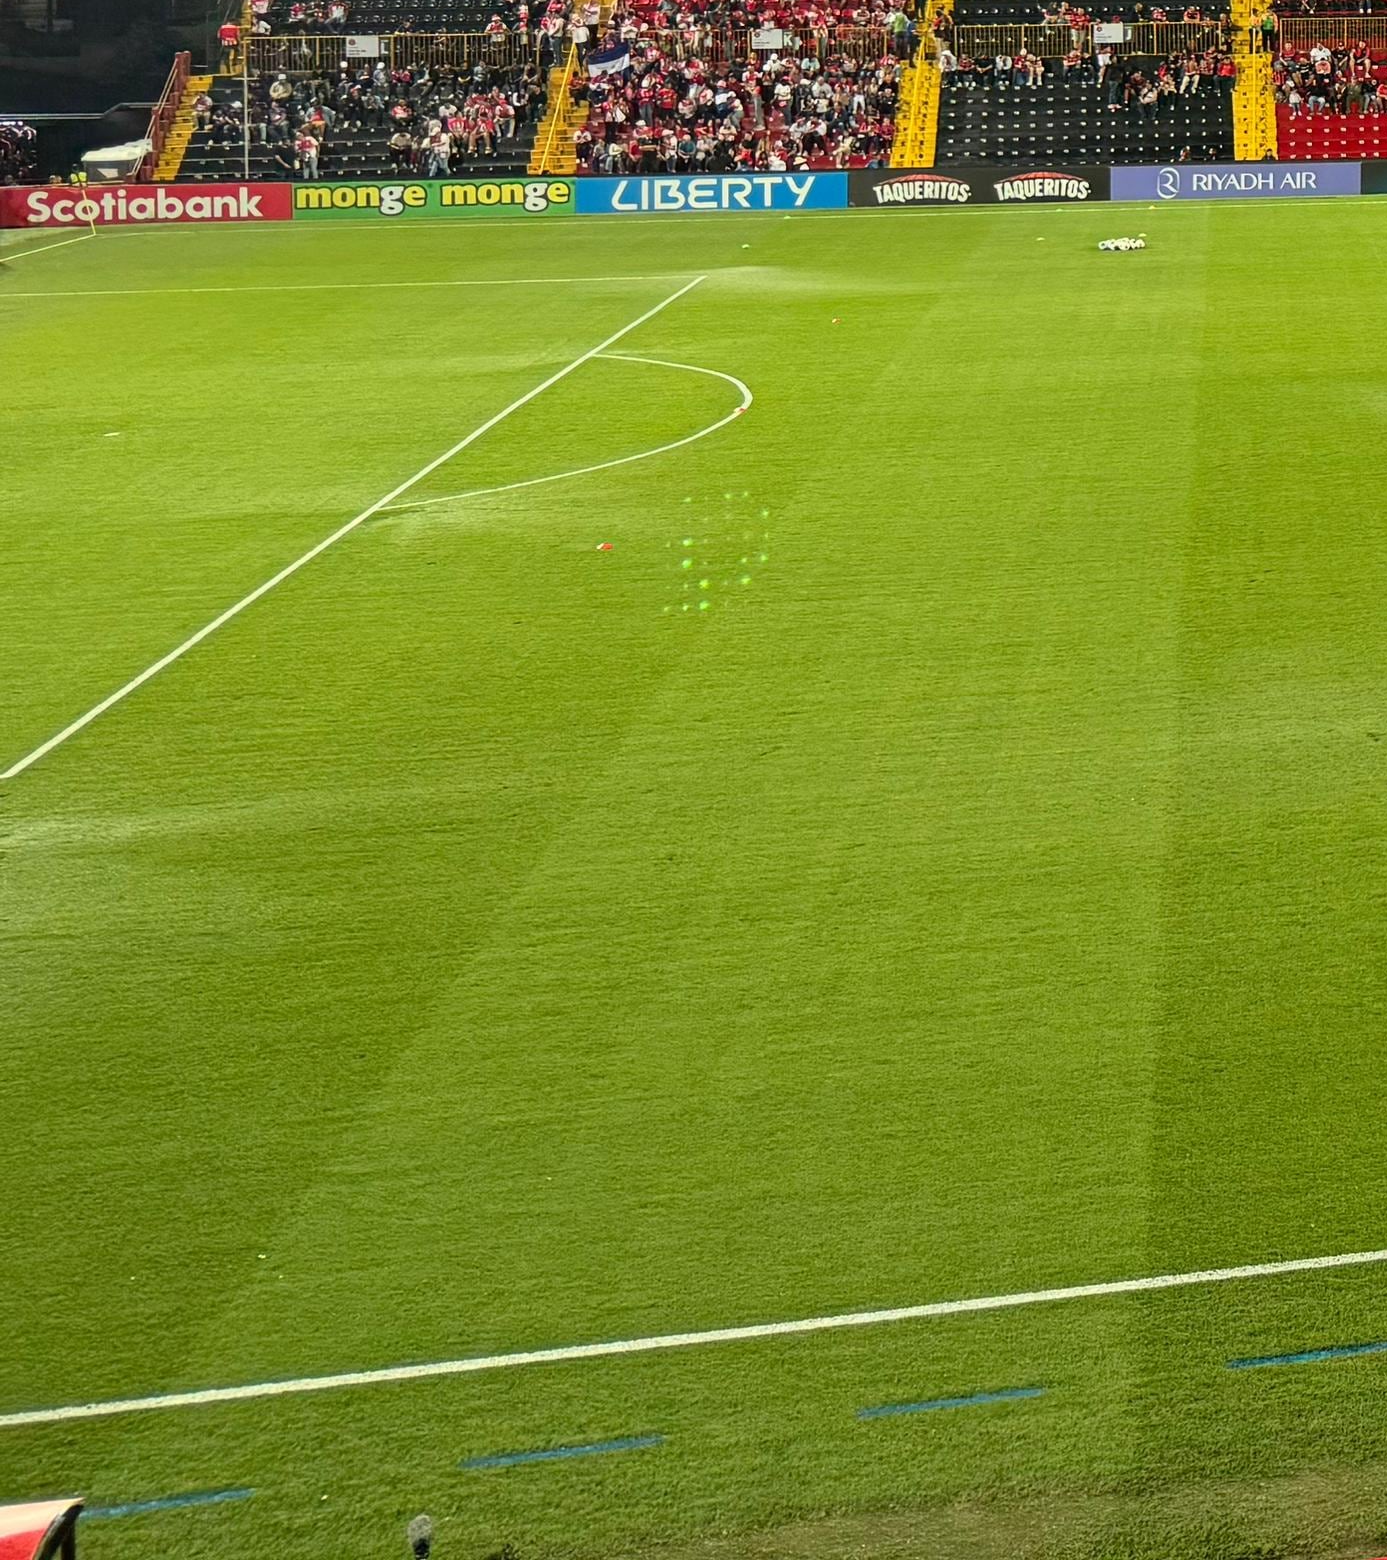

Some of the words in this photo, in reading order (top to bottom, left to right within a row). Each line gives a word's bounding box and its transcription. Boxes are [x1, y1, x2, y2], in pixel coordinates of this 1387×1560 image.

[611, 175, 816, 211] LIBERTY
[871, 181, 972, 205] TAQUERITOS
[992, 178, 1092, 202] TAQUERITOS
[1192, 173, 1274, 191] RIYADH
[1280, 171, 1317, 189] AIR
[26, 186, 264, 223] Scotiabank
[295, 182, 428, 216] monge
[441, 180, 571, 213] monge
